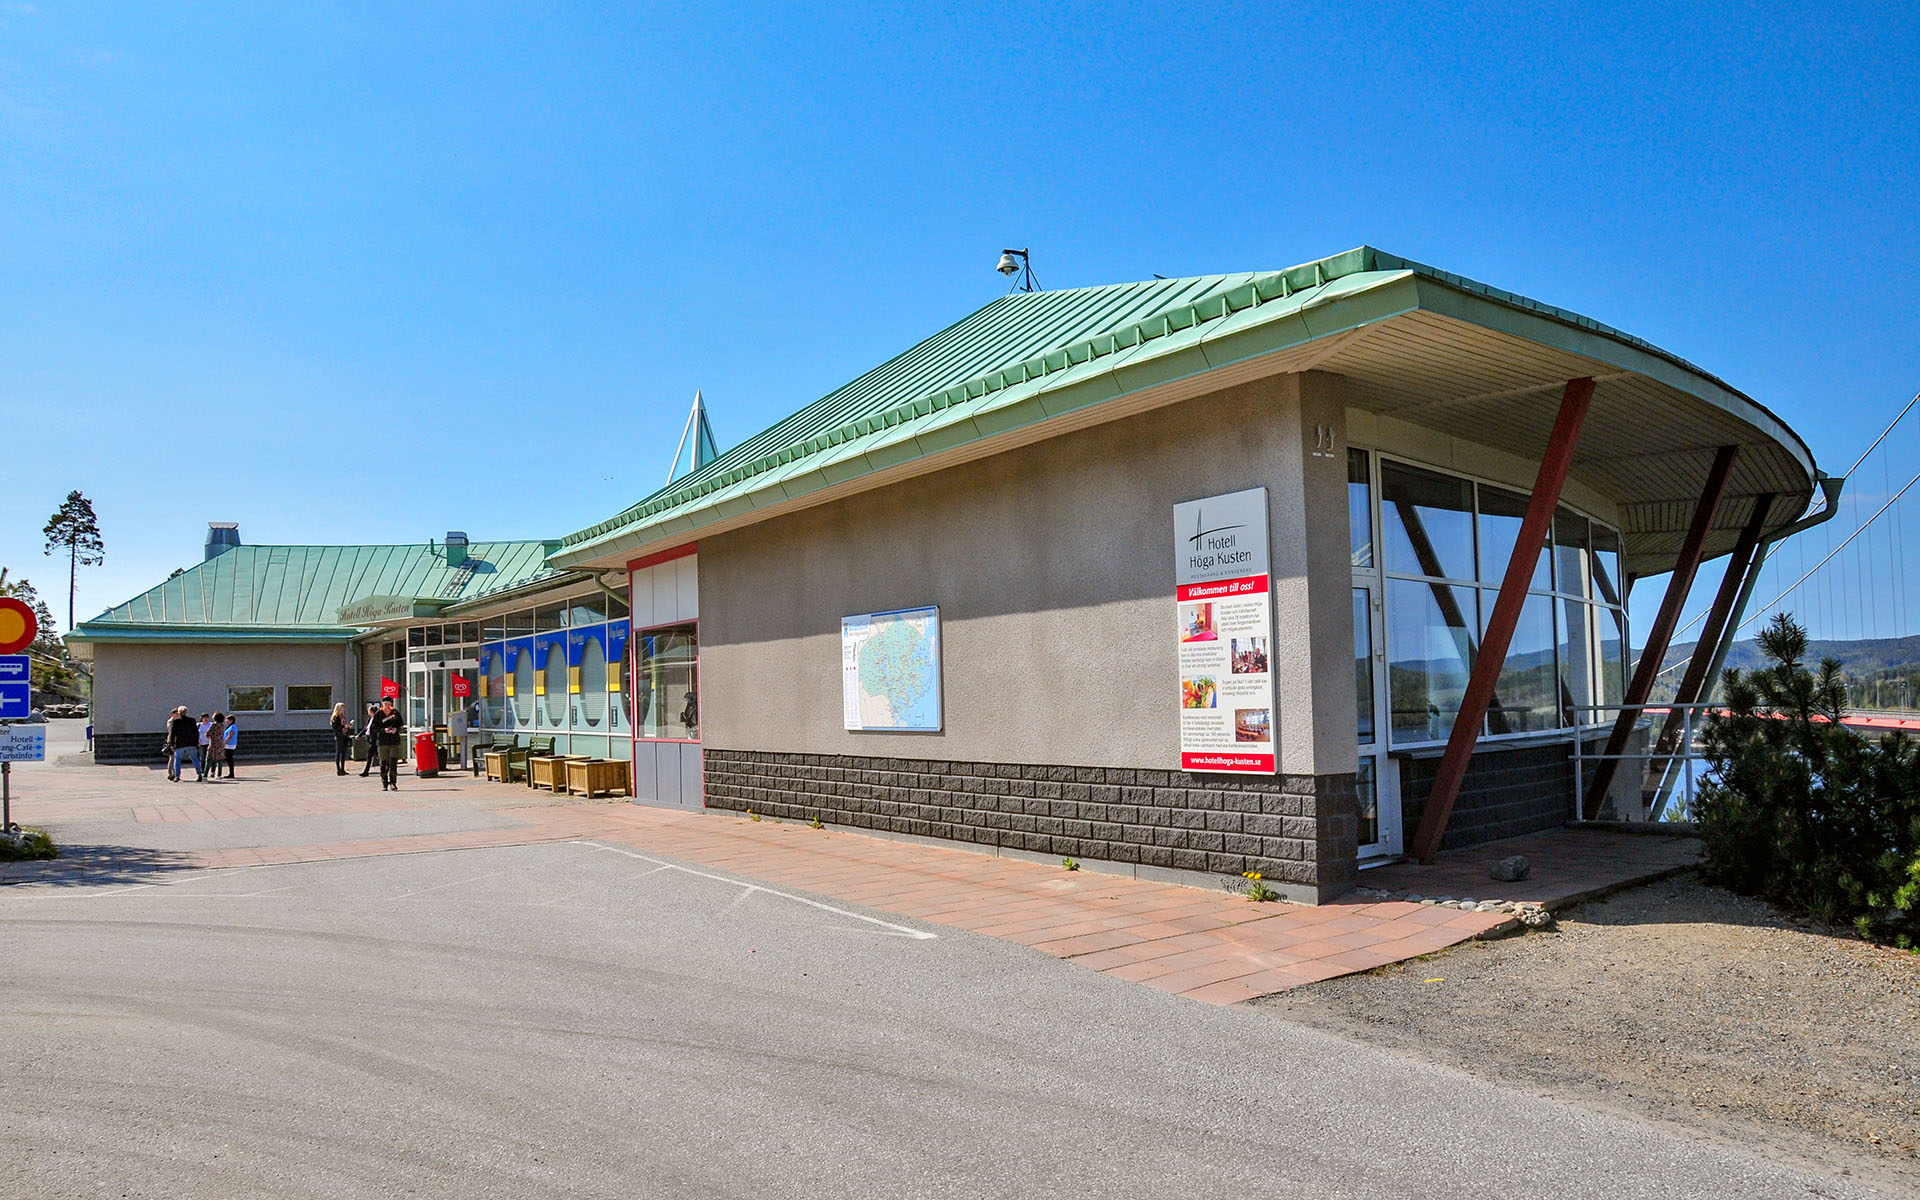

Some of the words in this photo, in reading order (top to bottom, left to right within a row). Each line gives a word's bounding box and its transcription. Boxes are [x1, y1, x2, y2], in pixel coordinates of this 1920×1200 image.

[1208, 535, 1236, 550] Hotell
[1190, 555, 1215, 570] Höga
[1217, 551, 1252, 565] Kusten
[1188, 586, 1228, 597] Välkommen
[1229, 582, 1239, 592] till
[1240, 581, 1254, 591] oss!
[340, 606, 361, 620] Hotell
[362, 605, 382, 620] Höga
[384, 602, 410, 615] Kusten
